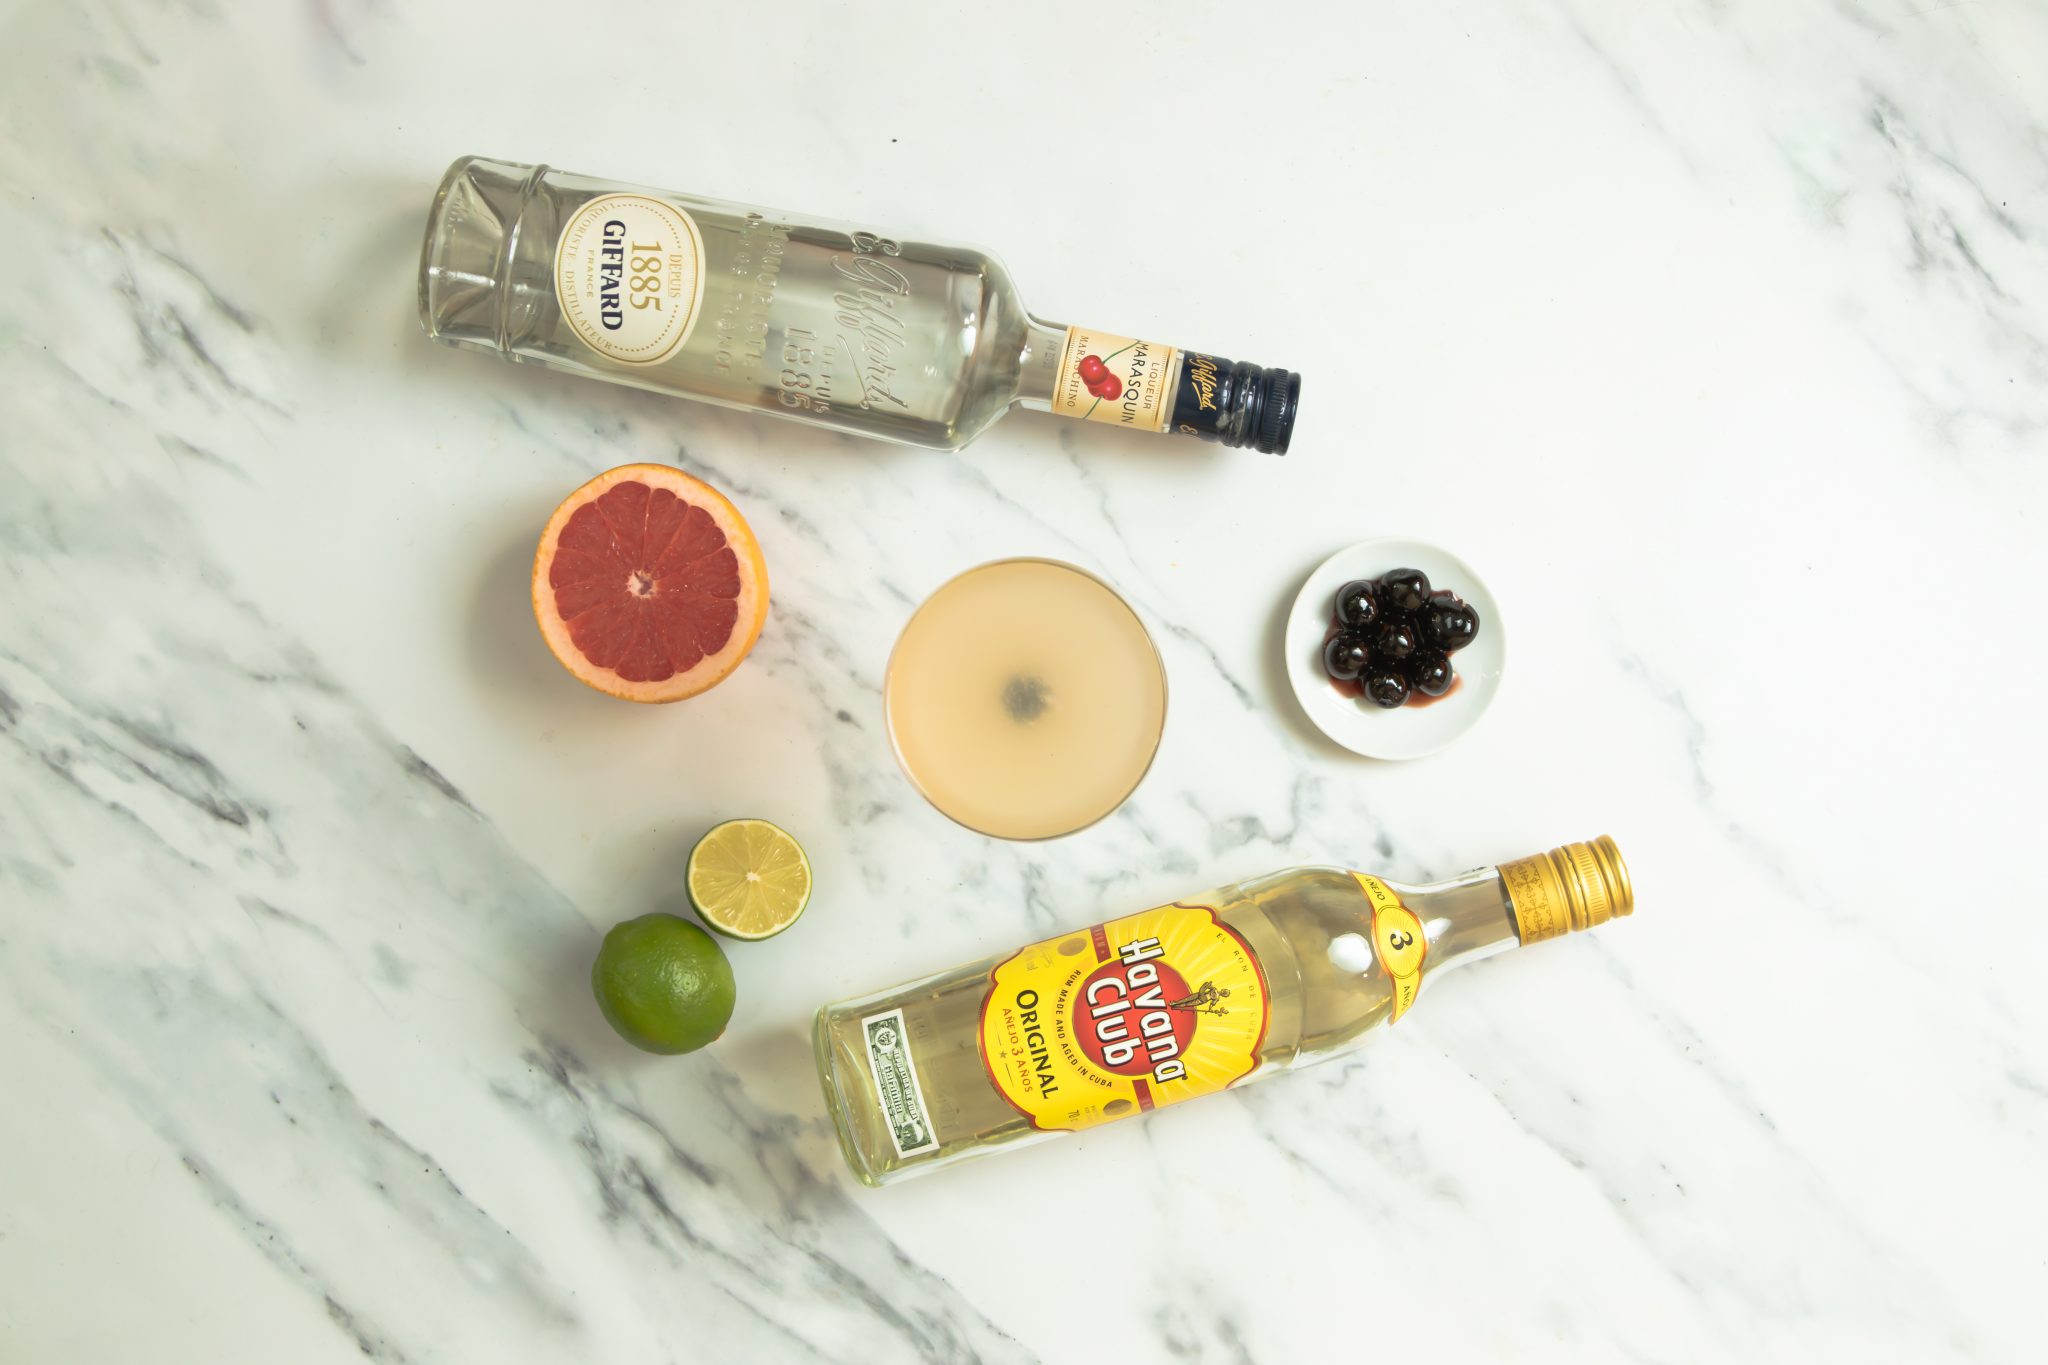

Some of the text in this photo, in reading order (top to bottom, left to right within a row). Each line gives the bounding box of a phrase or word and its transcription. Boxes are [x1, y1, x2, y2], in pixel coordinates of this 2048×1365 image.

[566, 203, 616, 350] LIQUORISTE DISTILLATEUR
[587, 249, 595, 298] FRANCE
[600, 220, 626, 331] GIFFARD
[630, 241, 663, 311] 1885
[669, 254, 683, 298] DEPUIS
[778, 327, 818, 408] 1885
[1121, 343, 1149, 424] MARASQUIN
[1143, 363, 1159, 409] LIQUEUR
[1216, 932, 1227, 944] EL
[1233, 950, 1248, 972] RON
[1249, 985, 1256, 999] DE
[1390, 931, 1413, 951] 3
[1055, 989, 1068, 1015] MADE
[1065, 969, 1082, 988] RUM
[1055, 1019, 1066, 1039] AND
[1086, 976, 1142, 1068] Club
[1118, 936, 1185, 1084] Havana
[1002, 1008, 1033, 1093] AÑEJO 3 AÑOS
[1016, 989, 1059, 1100] ORIGINAL
[1061, 1043, 1078, 1066] AGED
[1077, 1066, 1089, 1076] IN
[1089, 1074, 1113, 1088] CUBA
